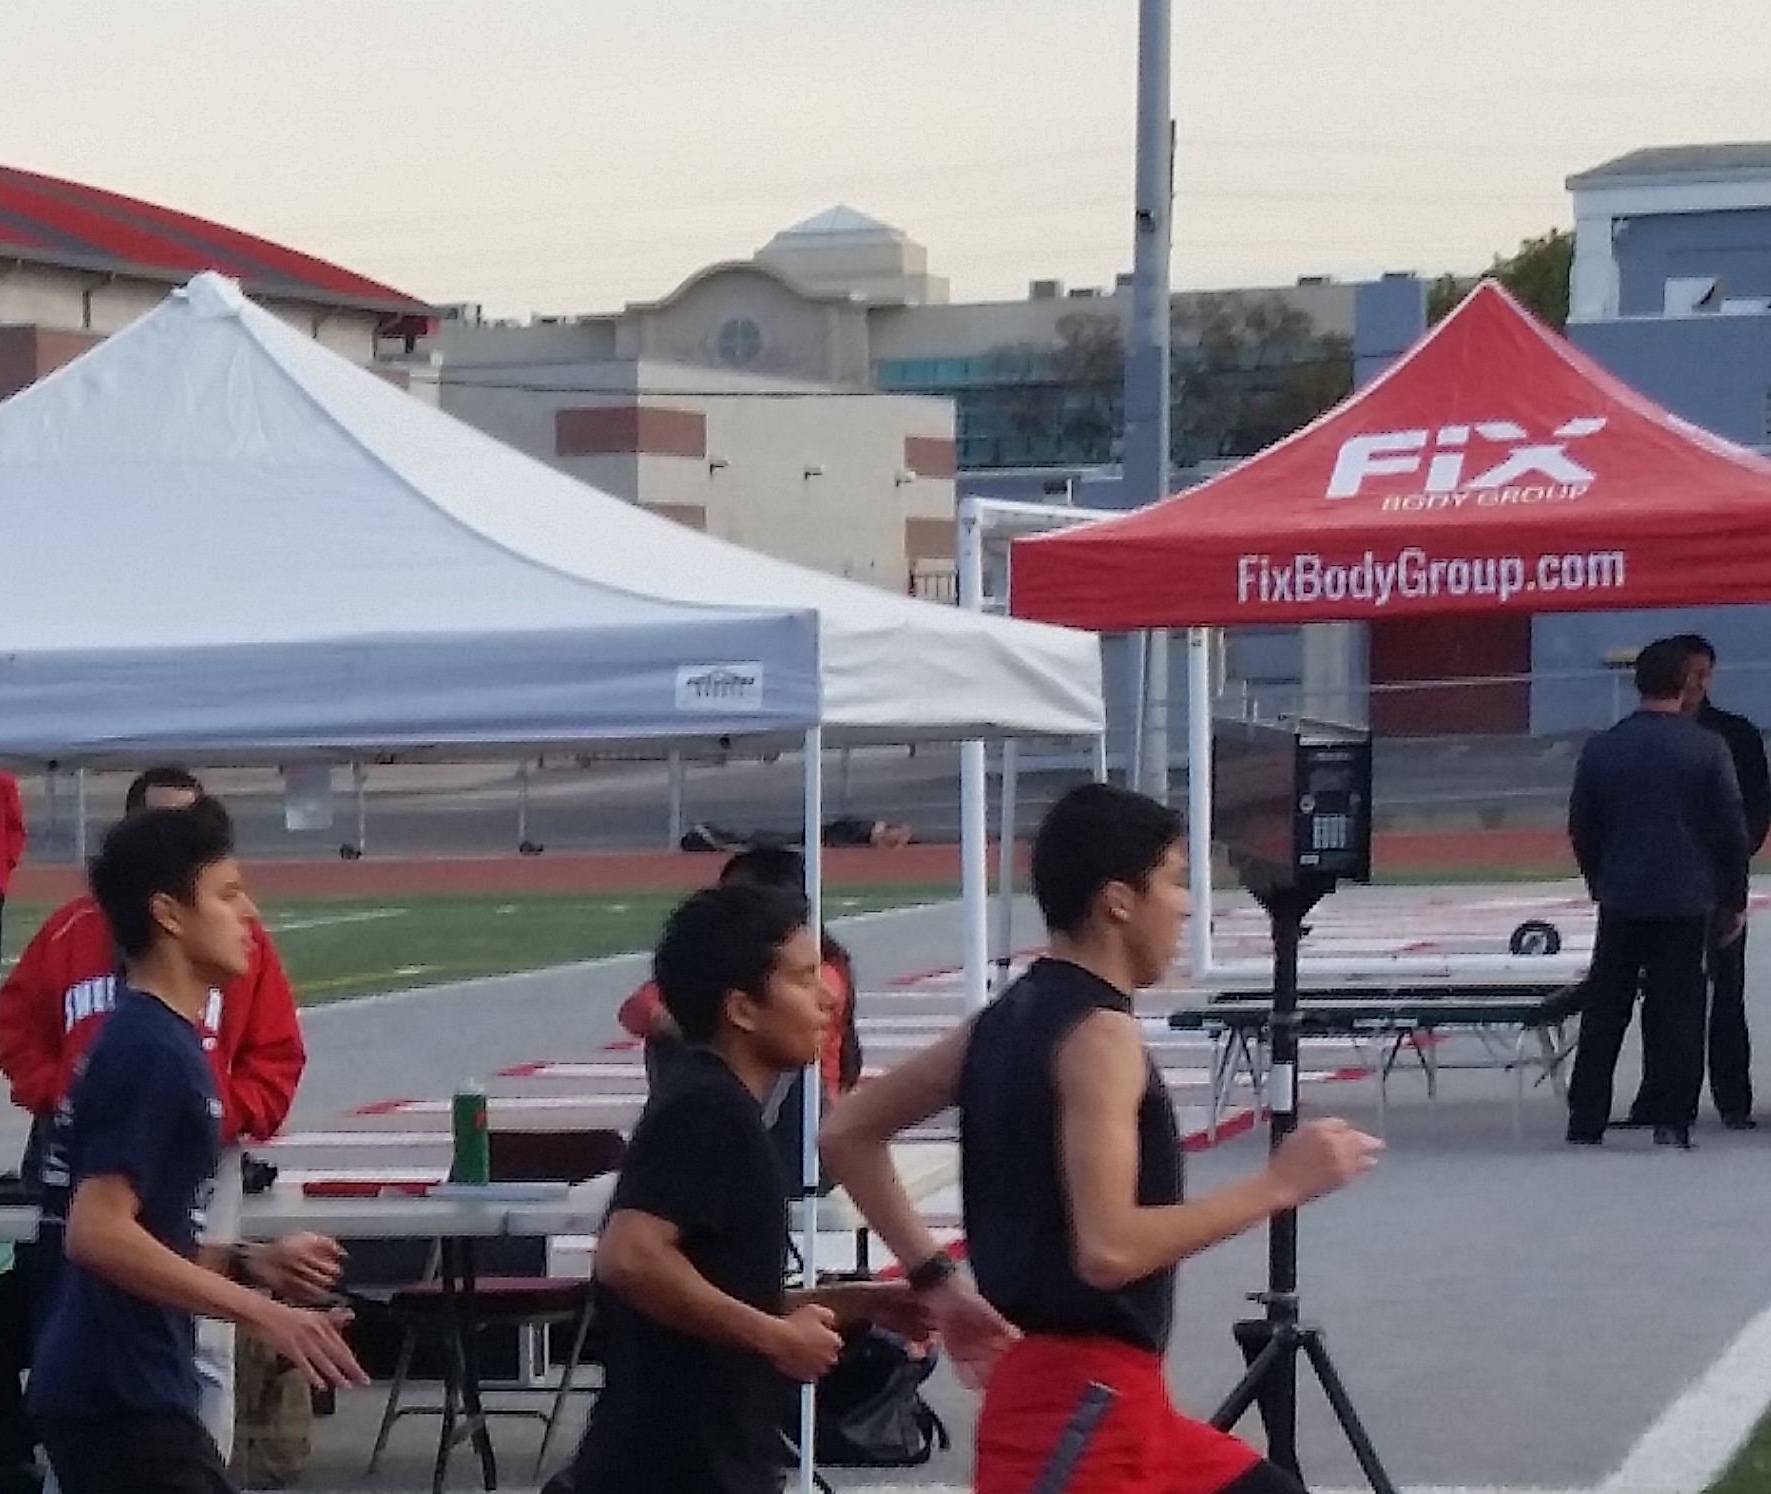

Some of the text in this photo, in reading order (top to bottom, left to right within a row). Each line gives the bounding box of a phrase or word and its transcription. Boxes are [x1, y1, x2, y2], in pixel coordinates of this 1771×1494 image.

[1381, 484, 1588, 512] BODY GROUP
[1237, 547, 1626, 607] FixBodyGroup.com
